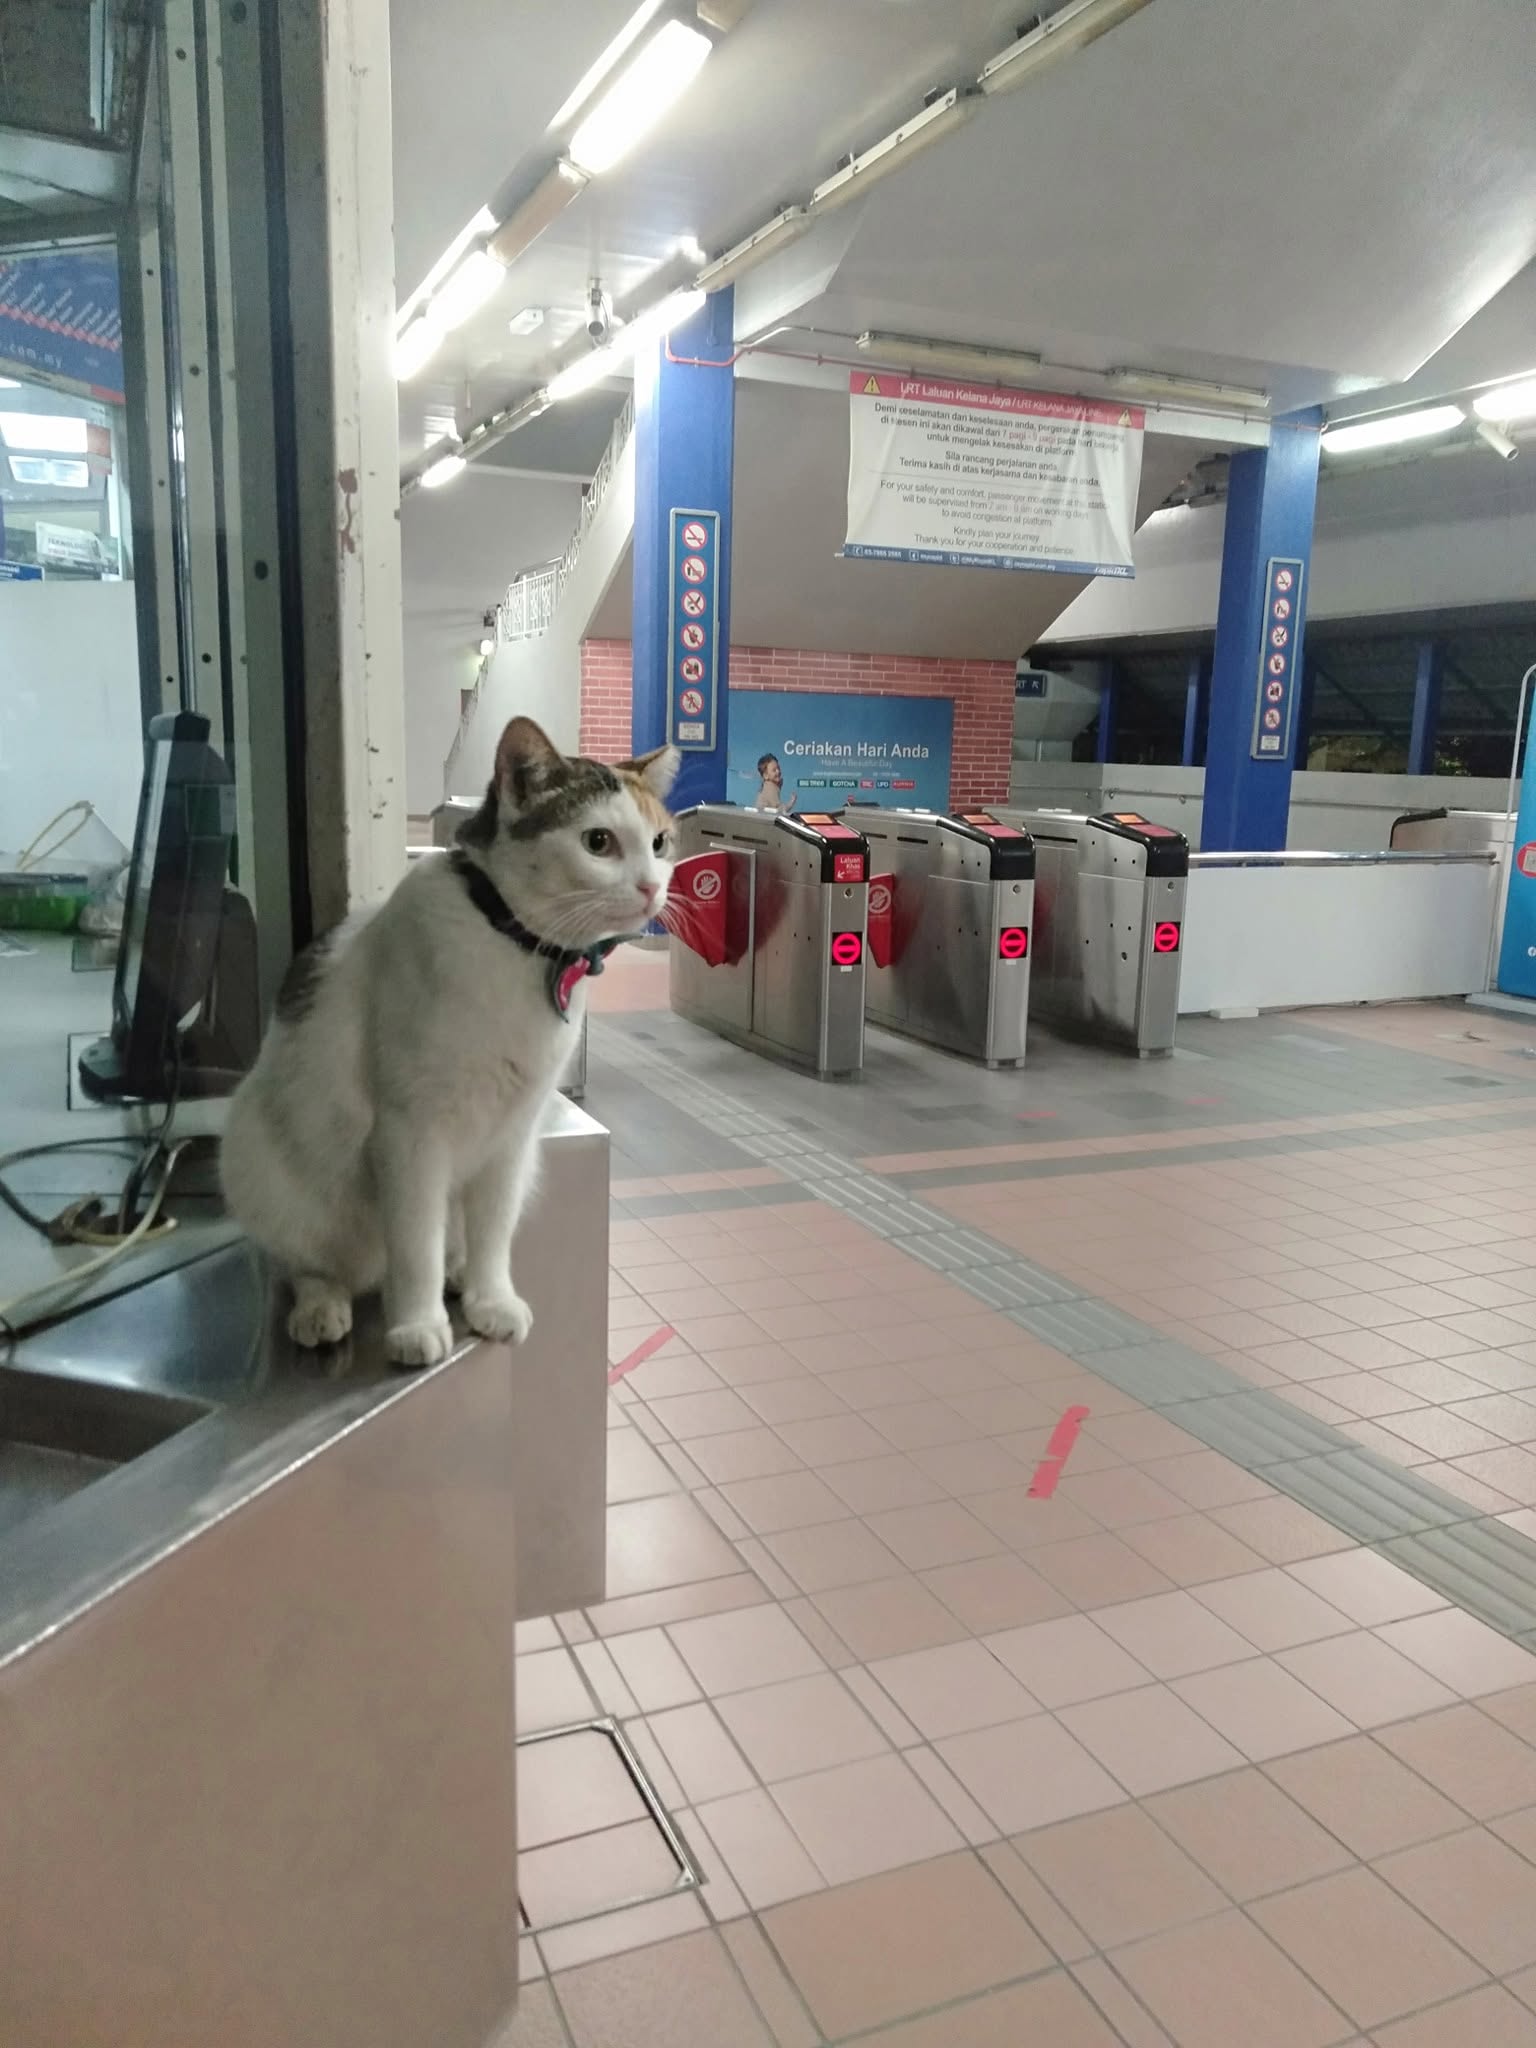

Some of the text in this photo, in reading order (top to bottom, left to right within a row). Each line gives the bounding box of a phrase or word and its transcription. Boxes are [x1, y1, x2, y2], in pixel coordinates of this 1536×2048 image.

[901, 381, 920, 394] LRT
[922, 384, 954, 400] Laluan
[956, 389, 987, 403] Kelana
[989, 393, 1011, 408] Jaya
[875, 402, 897, 413] Demi
[952, 412, 967, 422] dan
[881, 415, 889, 424] di
[932, 422, 951, 432] akan
[953, 424, 983, 435] dikawal
[927, 432, 949, 443] untuk
[952, 437, 991, 449] mengelak
[945, 450, 961, 460] Sila
[962, 455, 995, 467] rancang
[900, 457, 927, 468] Terima
[929, 461, 951, 471] kasih
[953, 465, 960, 473] di
[962, 466, 979, 474] atas
[1023, 472, 1038, 481] dan
[881, 480, 894, 489] For
[897, 483, 913, 492] your
[915, 484, 938, 495] safety
[940, 487, 955, 495] and
[903, 495, 915, 503] will
[917, 495, 926, 504] be
[970, 500, 988, 509] from
[942, 509, 949, 517] to
[951, 511, 971, 519] avoid
[915, 534, 938, 544] Thank
[954, 527, 976, 538] Kindly
[783, 740, 929, 759] Ceriakan Hari Anda
